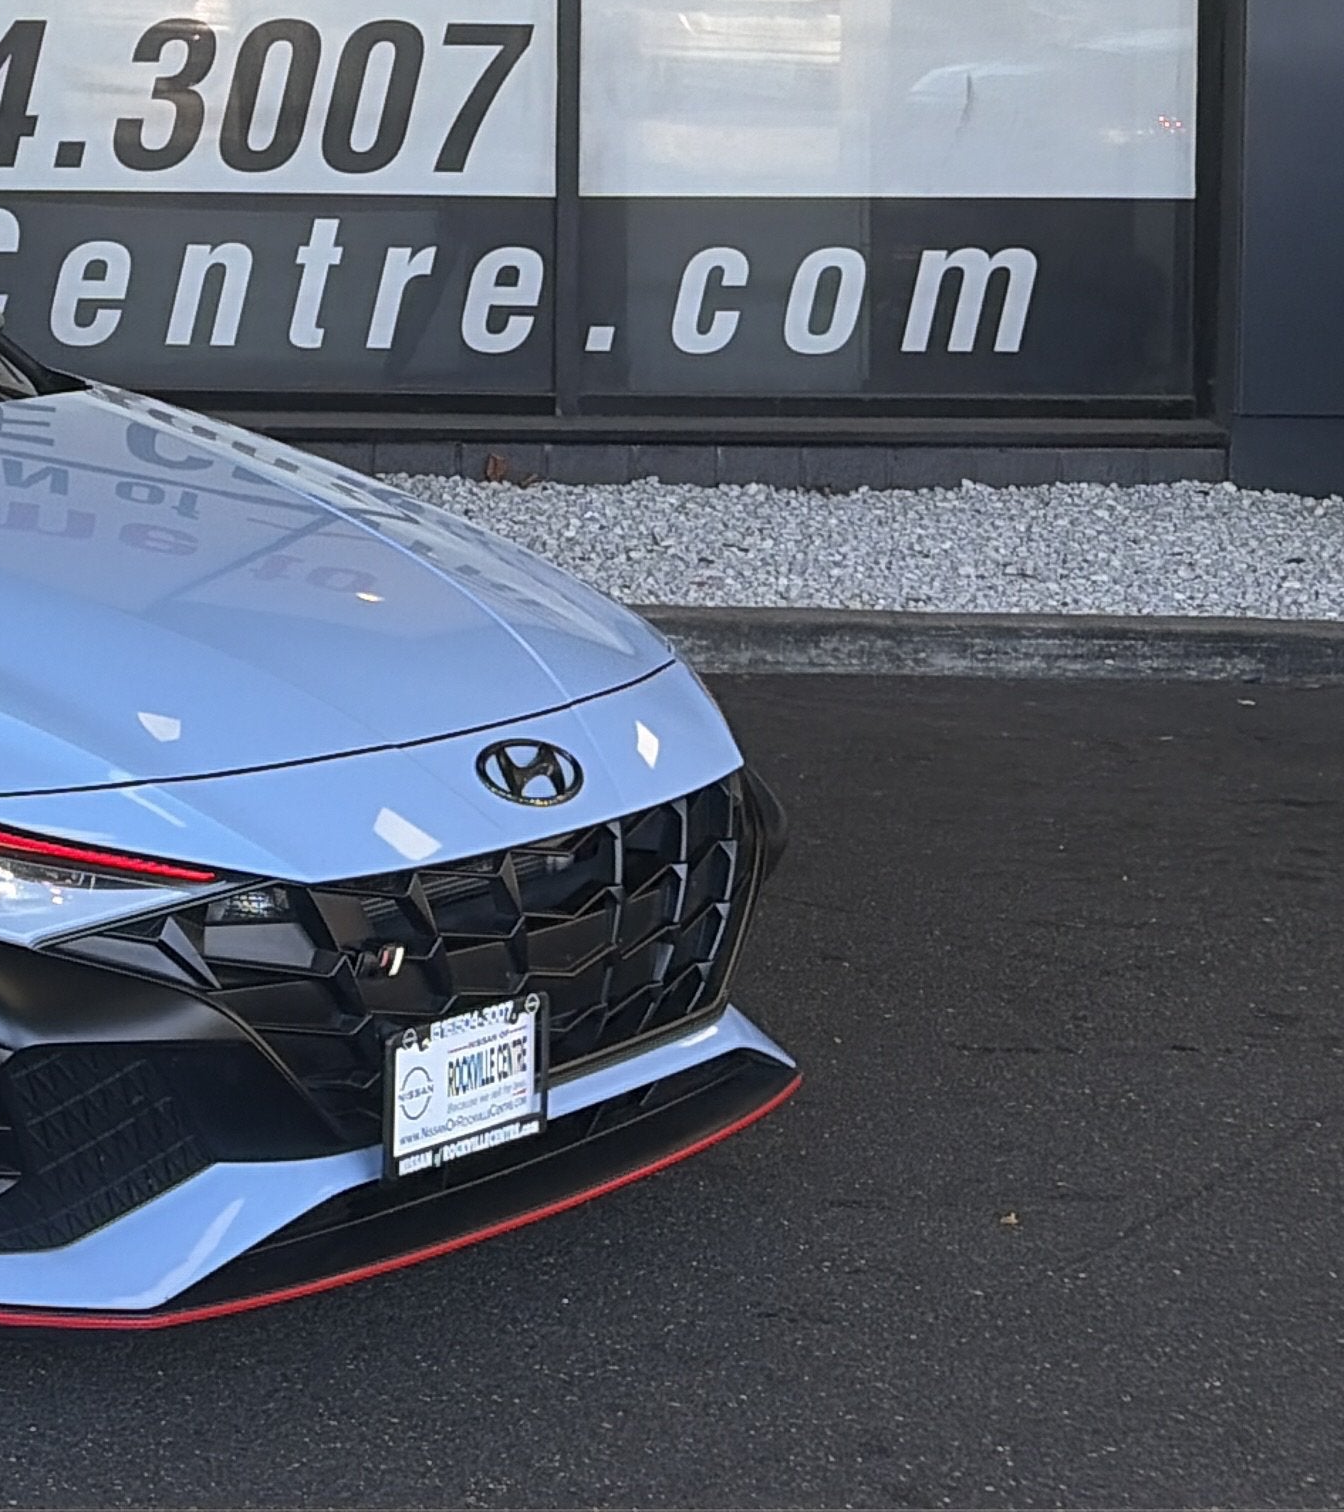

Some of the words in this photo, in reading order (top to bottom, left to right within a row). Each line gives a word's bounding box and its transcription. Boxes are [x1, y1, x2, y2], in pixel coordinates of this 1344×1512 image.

[447, 1046, 495, 1098] ROCKVILLE
[496, 1035, 528, 1081] CENTRE
[398, 1084, 434, 1102] NISSAN
